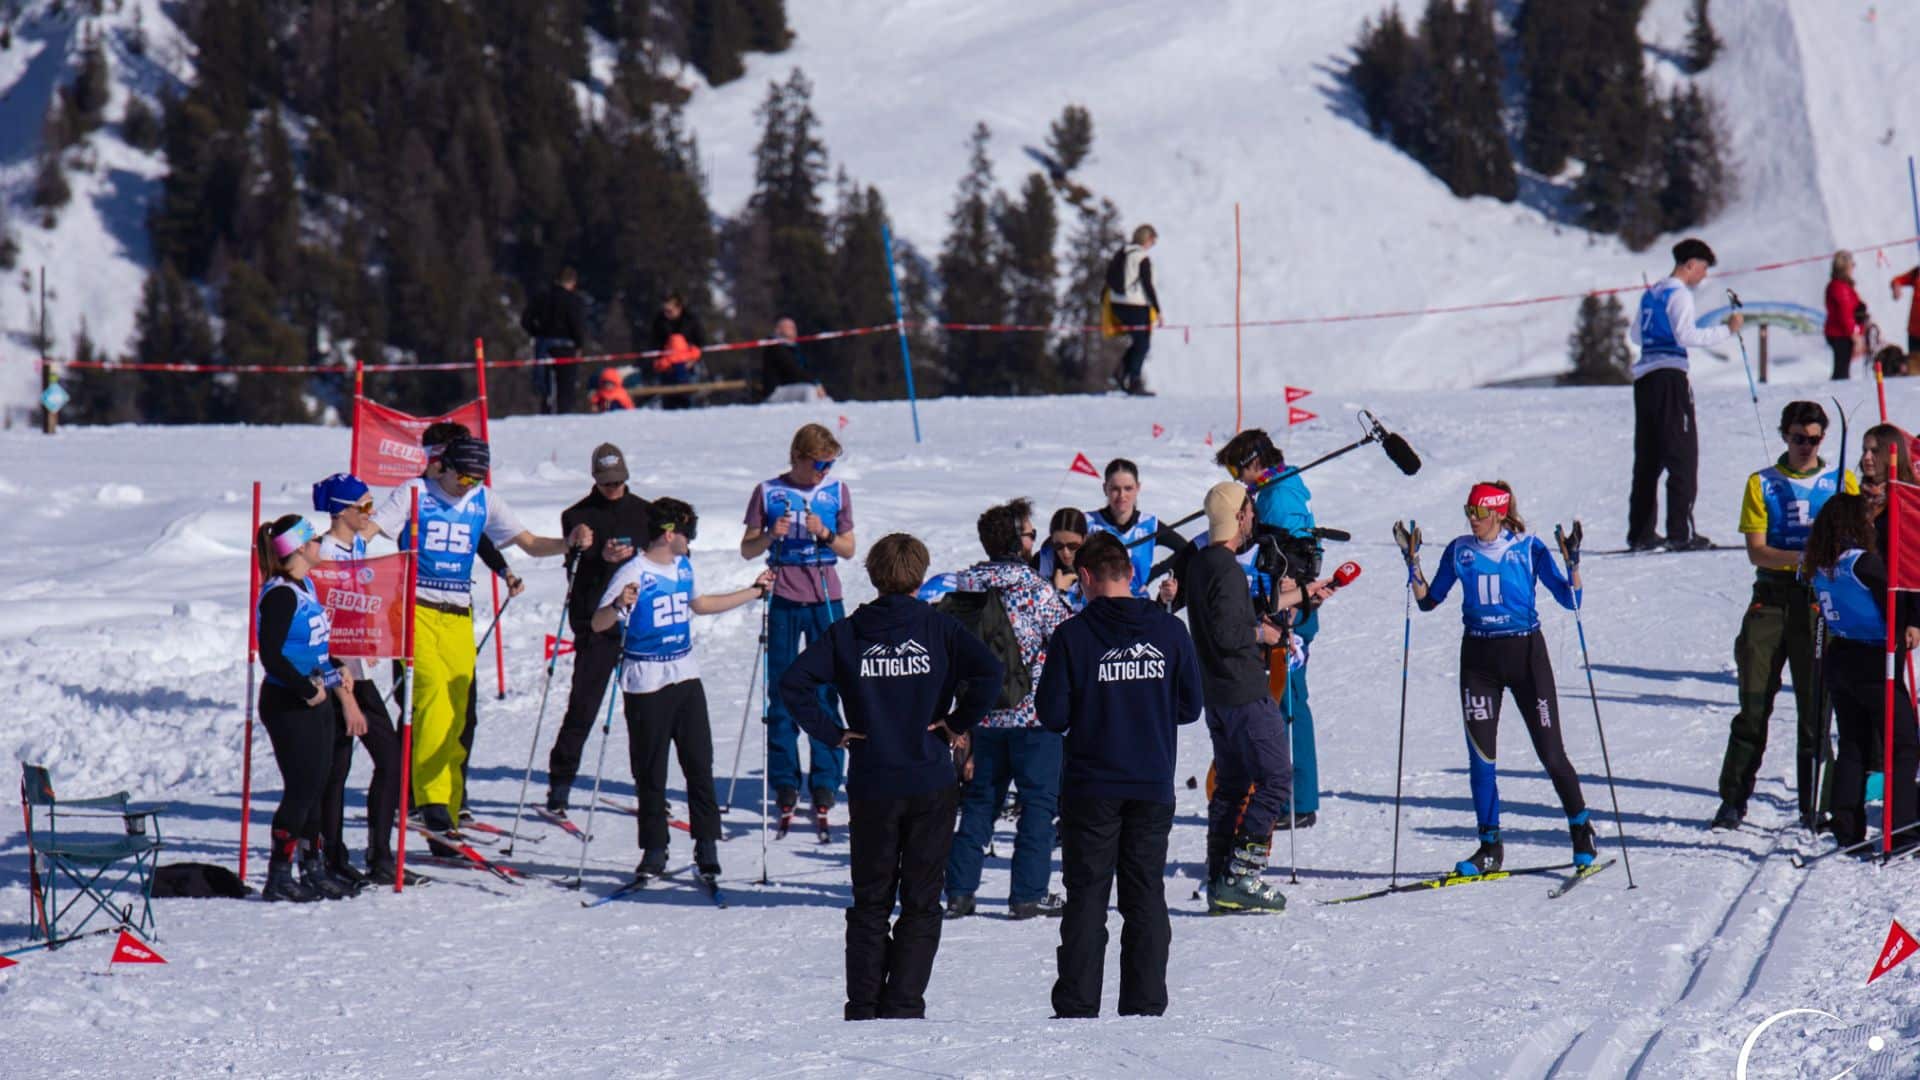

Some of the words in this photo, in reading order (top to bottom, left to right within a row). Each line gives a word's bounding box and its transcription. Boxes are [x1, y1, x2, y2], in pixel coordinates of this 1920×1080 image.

[424, 520, 470, 554] 25
[1478, 574, 1500, 605] 11
[653, 591, 689, 628] 25
[860, 655, 931, 677] ALTIGLISS
[1098, 659, 1166, 682] ALTIGLISS
